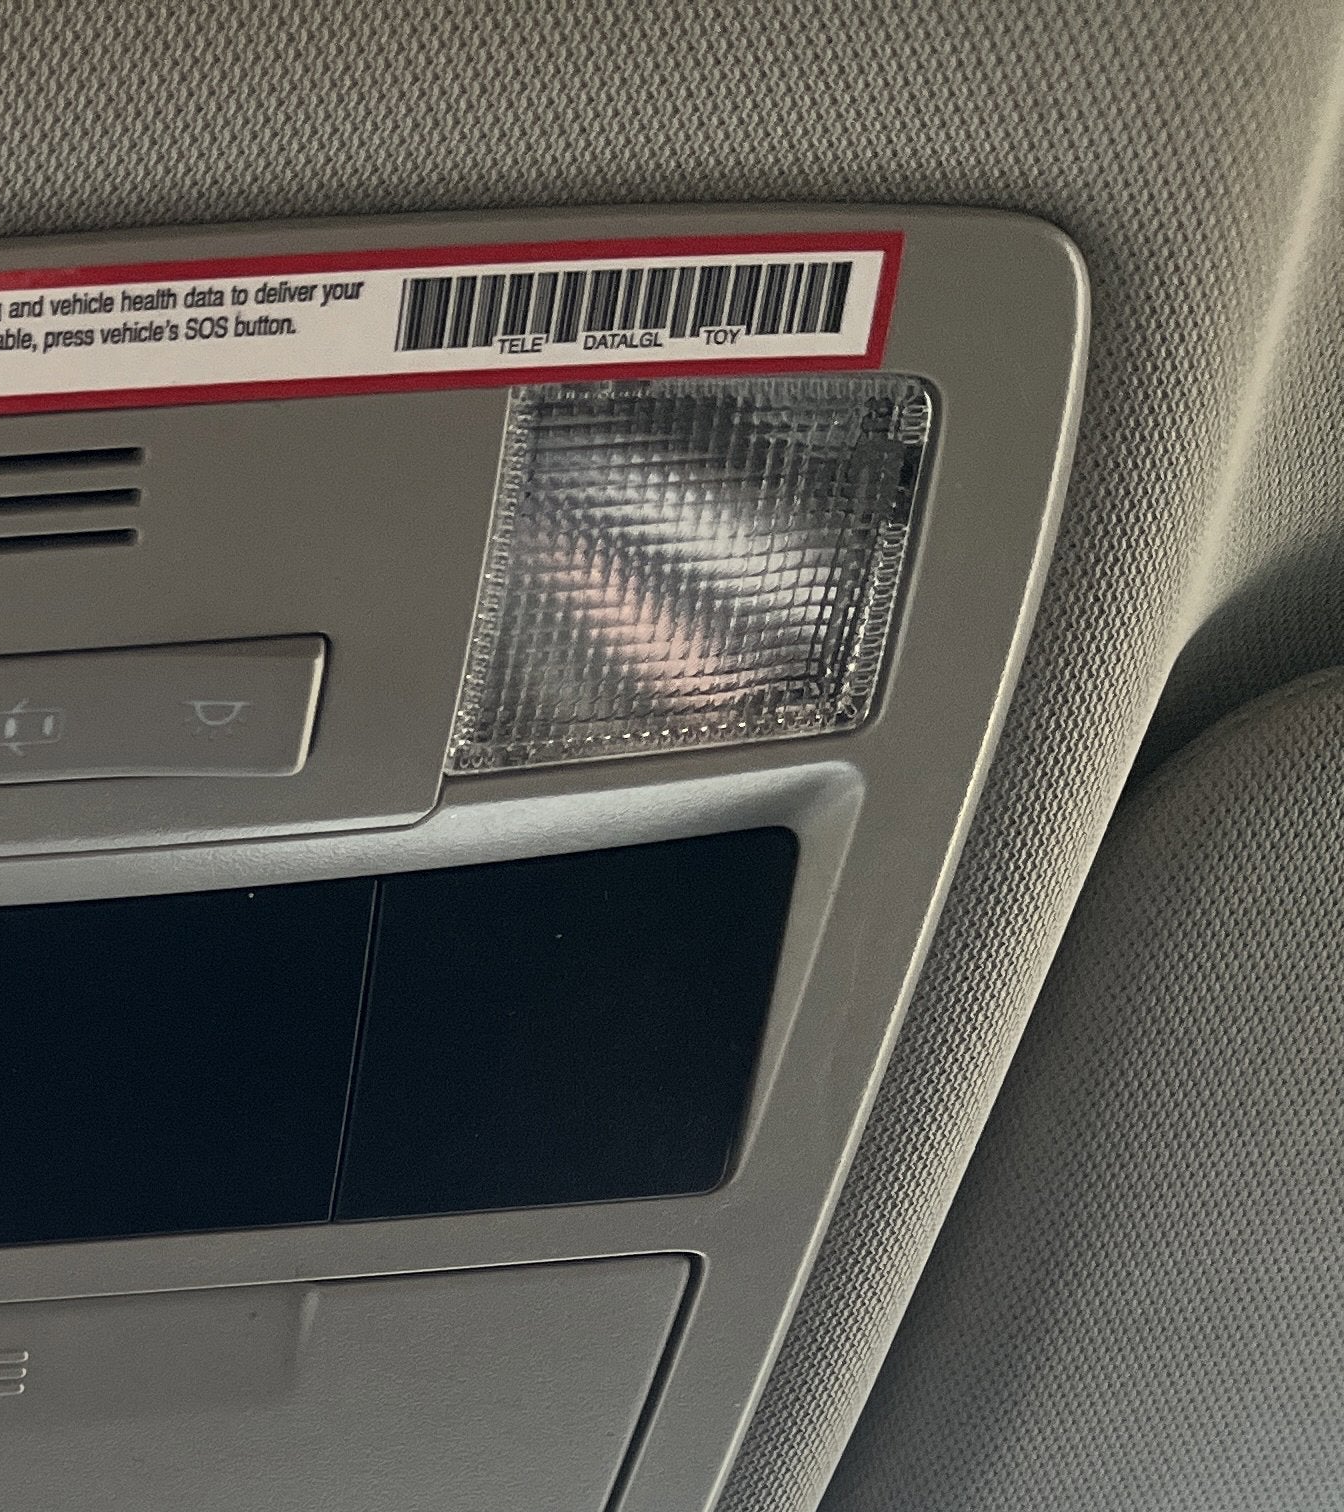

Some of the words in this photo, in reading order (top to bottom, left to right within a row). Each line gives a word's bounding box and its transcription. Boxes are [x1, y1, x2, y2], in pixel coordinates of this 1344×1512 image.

[8, 296, 44, 318] and
[50, 292, 115, 317] vehicle
[120, 287, 178, 312] health
[183, 285, 225, 309] data
[231, 285, 249, 306] to
[253, 281, 317, 305] deliver
[321, 281, 365, 307] your
[43, 328, 95, 354] press
[100, 319, 180, 345] vehicle's
[185, 316, 229, 340] SOS
[234, 315, 297, 338] button.
[497, 336, 544, 355] TELE
[582, 331, 663, 350] DATALGL
[703, 328, 742, 346] TOY
